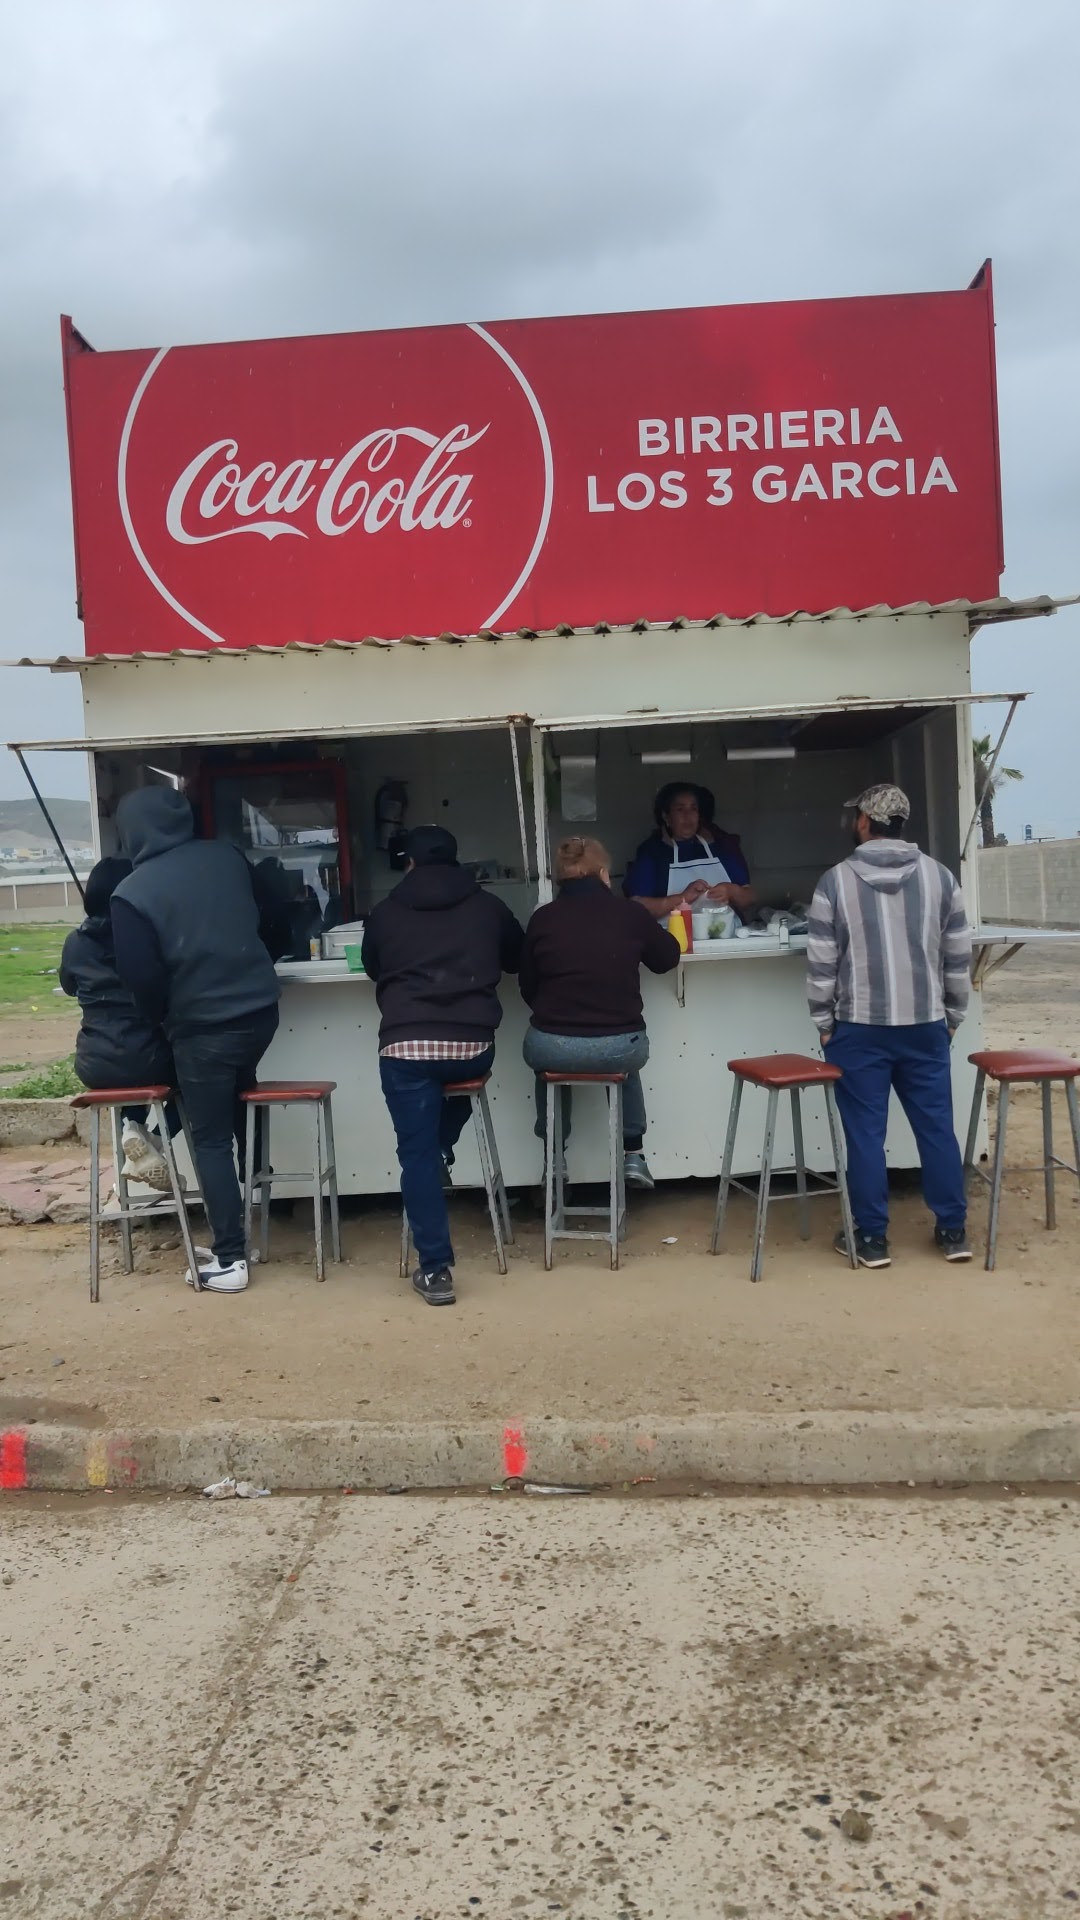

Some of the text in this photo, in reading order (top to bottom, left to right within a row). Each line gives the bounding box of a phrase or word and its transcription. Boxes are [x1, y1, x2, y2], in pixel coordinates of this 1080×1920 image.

[638, 406, 903, 457] BIRRIERIA
[165, 422, 491, 545] Coca-Cola
[587, 456, 959, 513] LOS 3 GARCIA
